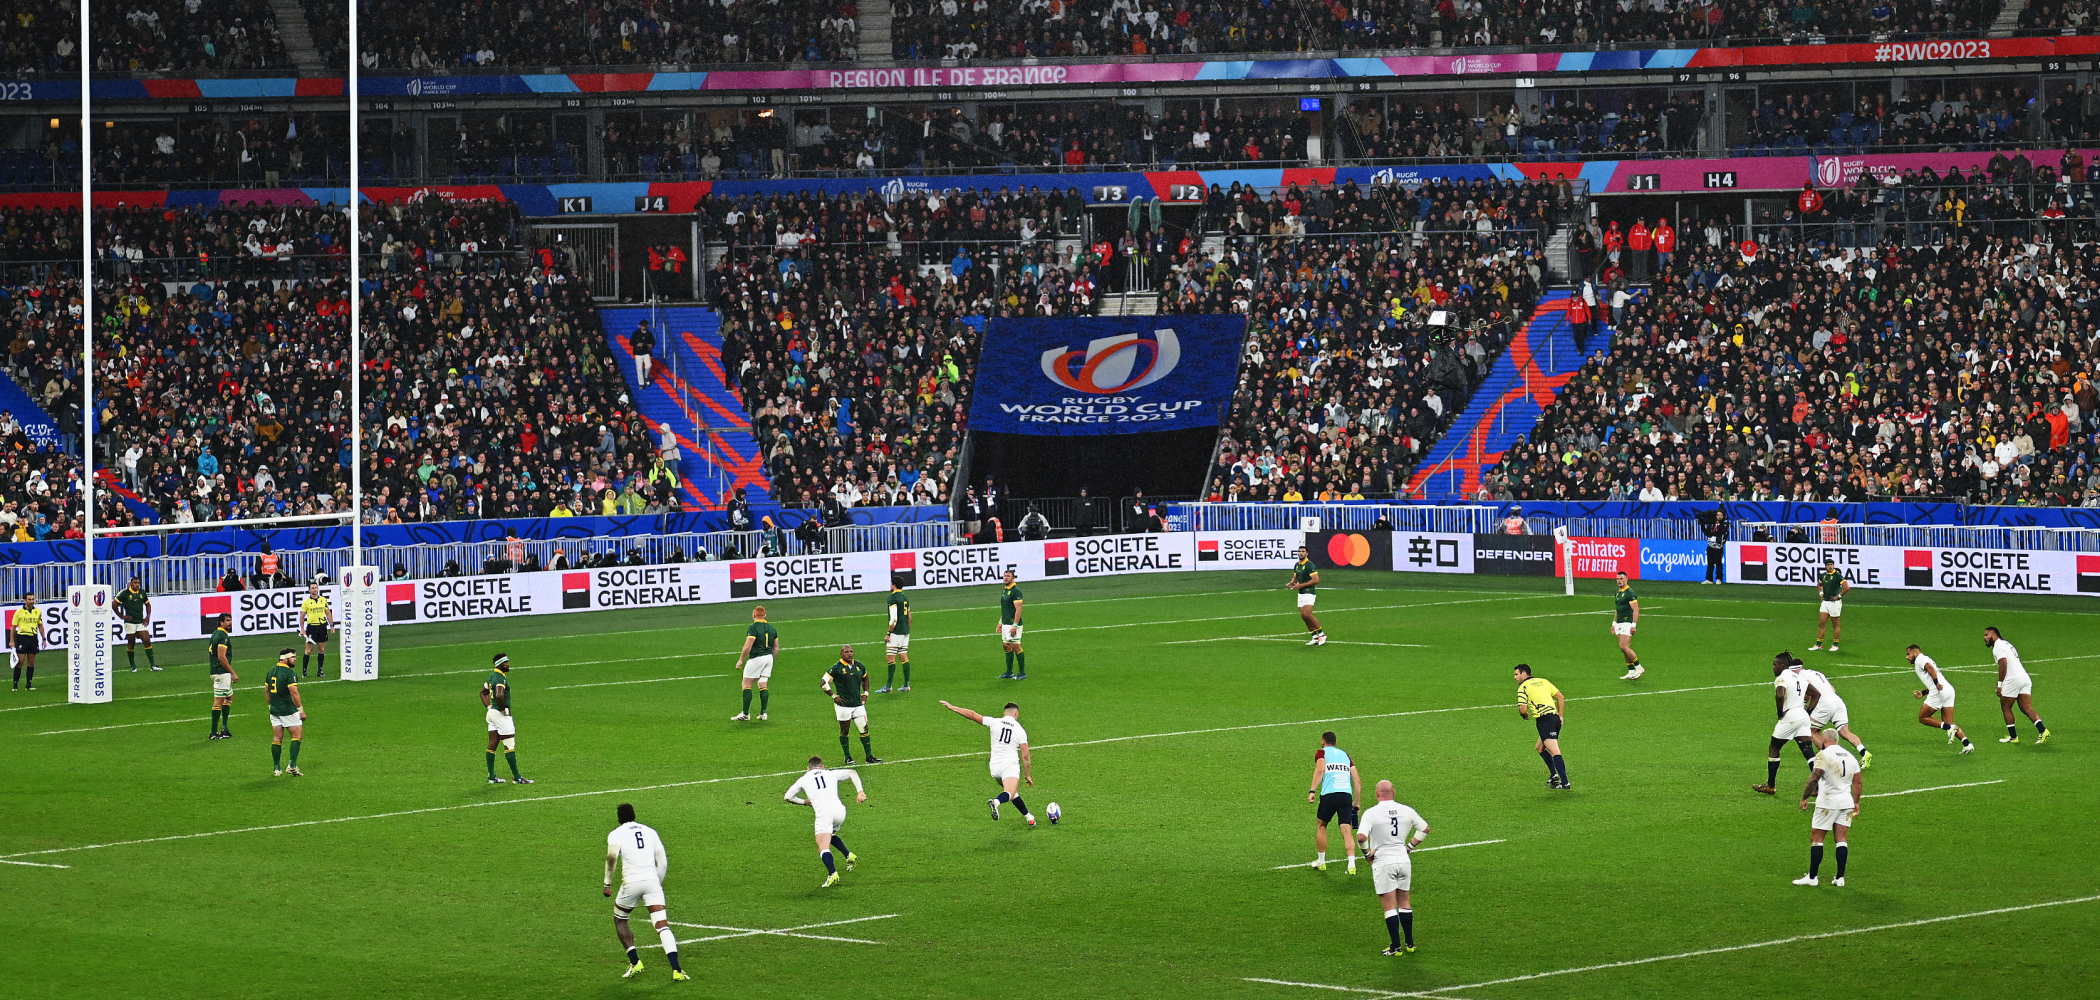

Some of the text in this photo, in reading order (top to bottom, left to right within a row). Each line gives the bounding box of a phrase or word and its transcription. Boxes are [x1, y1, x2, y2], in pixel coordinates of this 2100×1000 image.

[1875, 41, 1990, 61] #RWC2023
[2049, 62, 2059, 70] 95
[830, 69, 905, 88] REGION
[914, 69, 942, 87] ILE
[951, 68, 975, 86] DE
[1123, 88, 1137, 96] 100
[1000, 400, 1203, 415] WORLD CUP
[1062, 396, 1142, 404] RUGBY
[1019, 412, 1177, 423] FRANCE 2023
[1075, 537, 1159, 556] SOCIETE
[1224, 538, 1285, 550] SOCIETE
[1408, 535, 1458, 567] 辛口
[1570, 540, 1626, 558] Emirates
[923, 547, 1000, 567] SOCIETE
[1075, 553, 1182, 574] GENERALE
[1224, 549, 1299, 561] GENERALE
[1476, 548, 1553, 562] DEFENDER
[1640, 547, 1708, 573] Capgemini
[1775, 546, 1860, 565] SOCIETE
[1940, 551, 2029, 570] SOCIETE
[764, 557, 843, 577] SOCIETE
[1577, 558, 1617, 572] FLY BETTER
[597, 567, 681, 588] SOCIETE
[764, 574, 862, 596] GENERALE
[1940, 570, 2051, 591] GENERALE
[423, 578, 511, 599] SOCIETE
[597, 585, 700, 607] GENERALE
[365, 600, 373, 627] 2023
[423, 596, 531, 619] GENERALE
[903, 601, 908, 615] 5
[765, 633, 769, 648] 1
[270, 676, 277, 693] 3
[1796, 681, 1802, 696] 4
[999, 727, 1013, 744] 10
[1842, 760, 1846, 778] 1
[815, 775, 826, 790] 11
[1391, 817, 1398, 837] 3
[634, 831, 645, 849] 6
